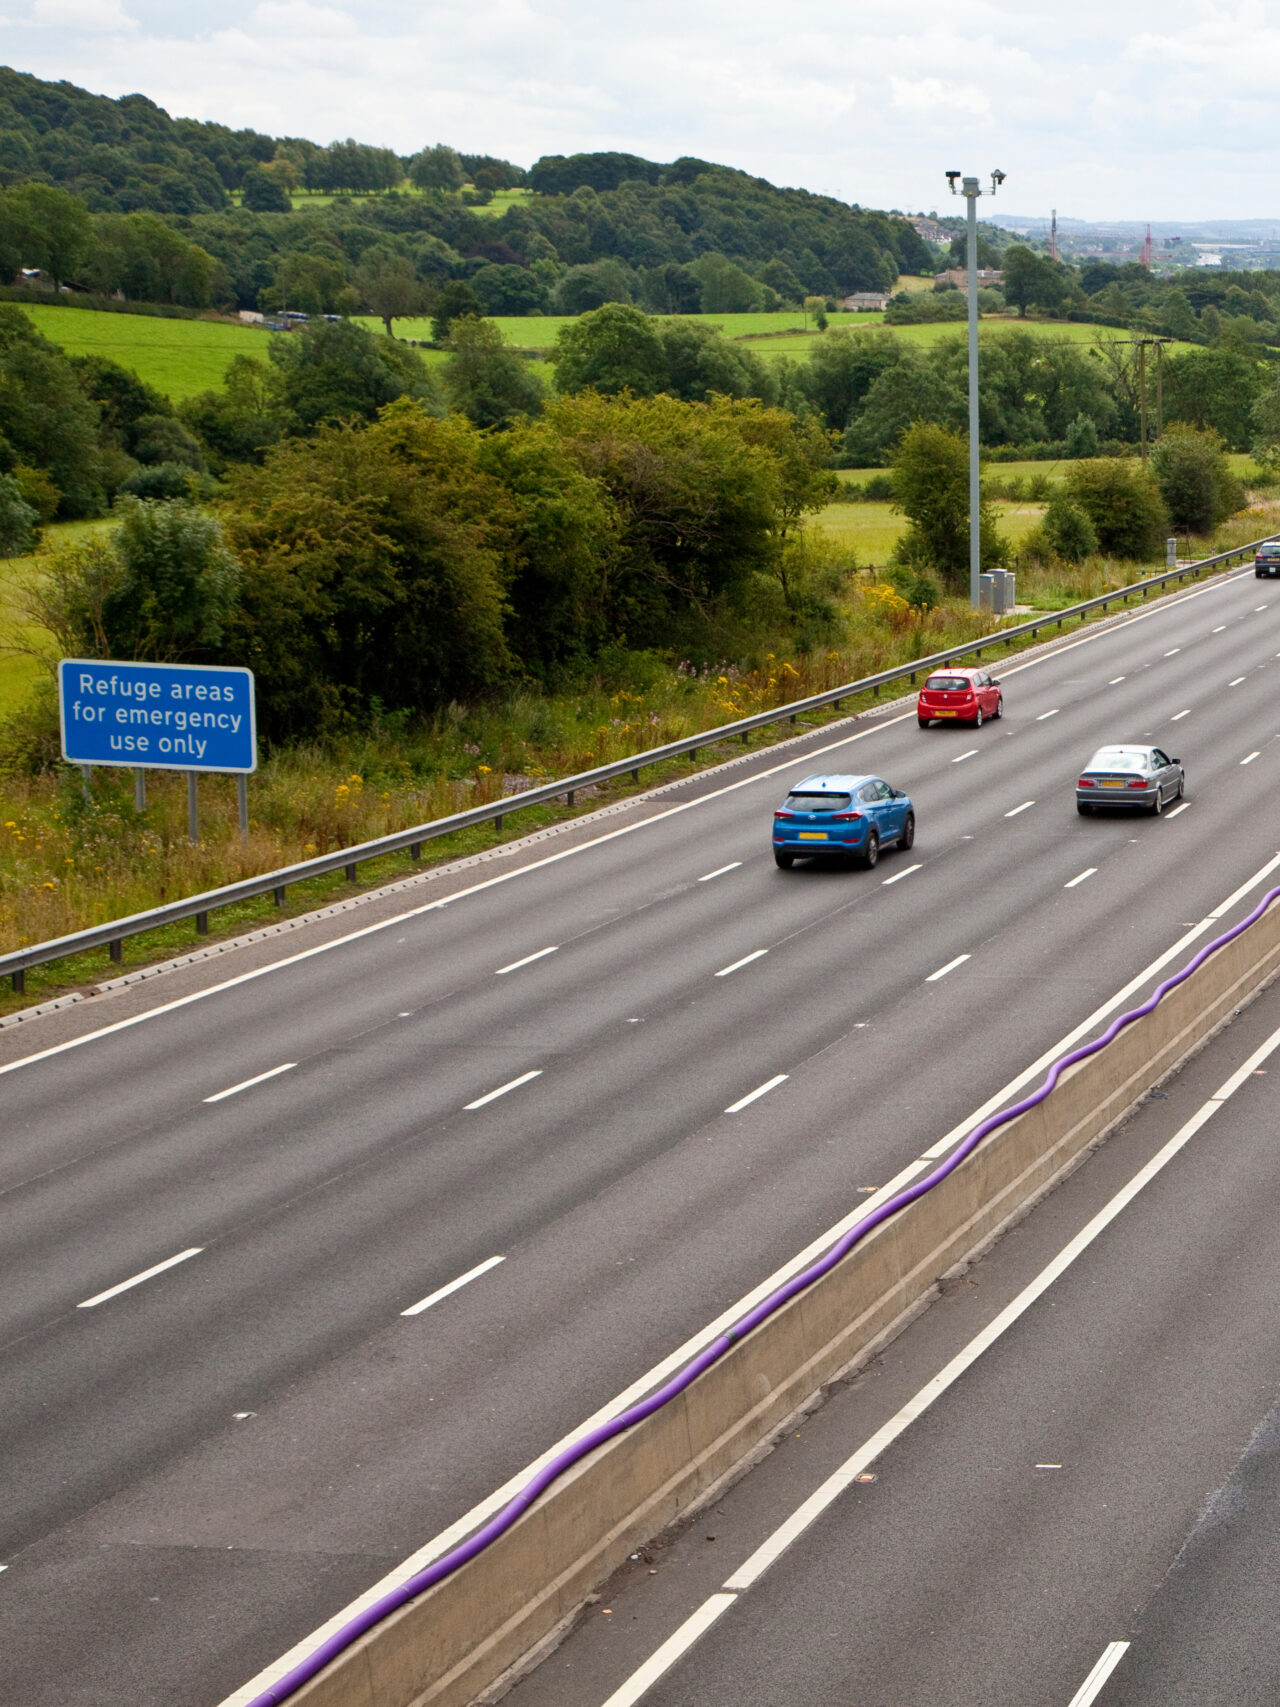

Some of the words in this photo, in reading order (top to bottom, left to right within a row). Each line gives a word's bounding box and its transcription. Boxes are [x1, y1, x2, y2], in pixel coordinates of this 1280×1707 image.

[79, 674, 161, 701] Refuge
[170, 683, 234, 702] areas
[73, 701, 106, 722] for
[115, 707, 242, 733] emergency
[110, 735, 149, 751] use
[158, 734, 207, 759] only
